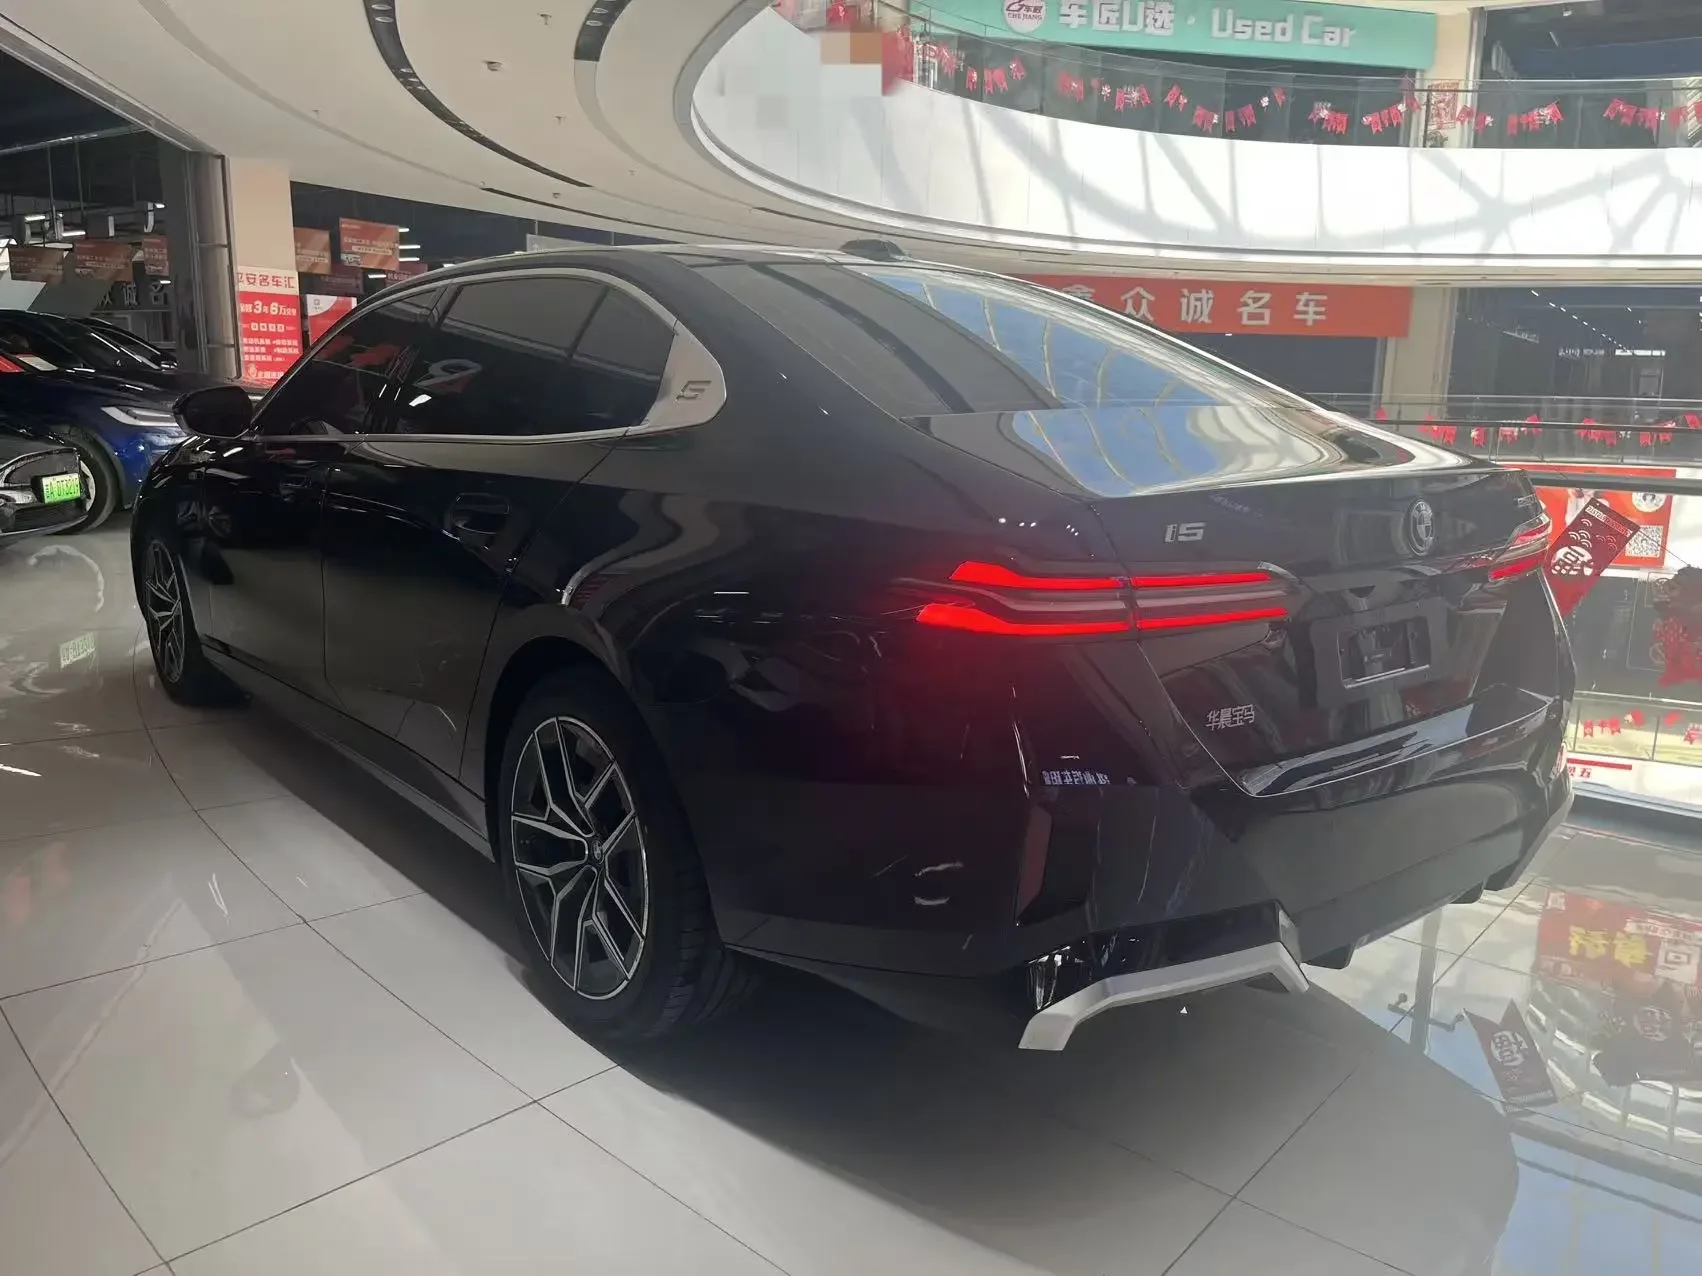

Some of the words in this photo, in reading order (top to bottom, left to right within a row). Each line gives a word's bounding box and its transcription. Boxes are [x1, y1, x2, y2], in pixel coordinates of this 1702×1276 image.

[1210, 7, 1294, 43] Used
[1301, 14, 1357, 47] Car
[1165, 521, 1206, 543] i5
[1205, 704, 1256, 731] 华晨宝马
